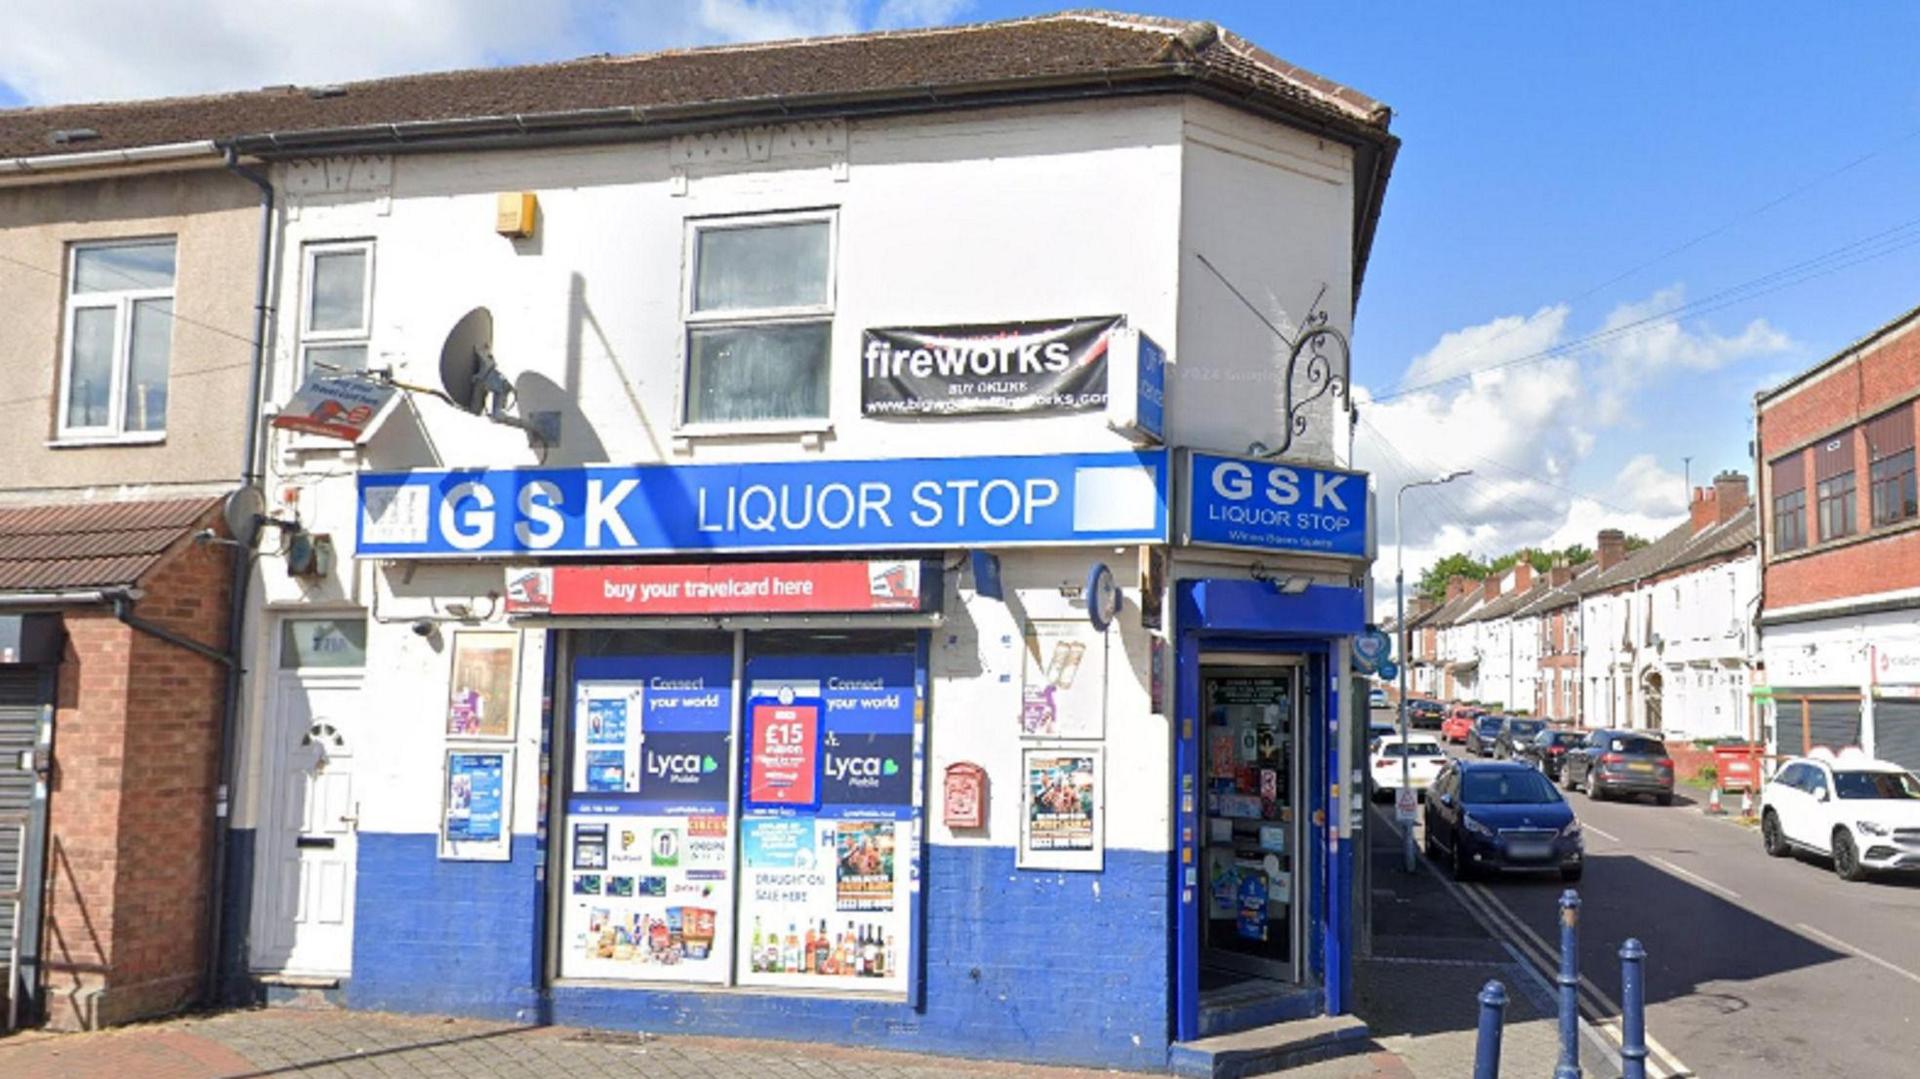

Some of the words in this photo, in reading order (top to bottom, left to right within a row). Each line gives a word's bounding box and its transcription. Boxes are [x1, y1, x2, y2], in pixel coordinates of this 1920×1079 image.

[865, 340, 1070, 379] fireworks
[949, 383, 974, 394] BUY
[699, 483, 892, 532] LIQUOR
[911, 479, 1059, 528] STOP
[1209, 504, 1290, 527] LIQUOR
[1297, 513, 1349, 532] STOP
[604, 579, 635, 601] buy
[640, 582, 680, 599] your
[685, 578, 770, 598] travelcard
[773, 578, 813, 597] here
[650, 677, 703, 690] Connect
[827, 677, 884, 690] Connect
[649, 697, 679, 711] your
[682, 694, 719, 708] world
[826, 698, 857, 711] your
[861, 695, 899, 709] world
[765, 723, 803, 744] £15
[648, 751, 700, 778] Lyca
[825, 753, 881, 780] Lyca
[849, 778, 879, 787] Mobile
